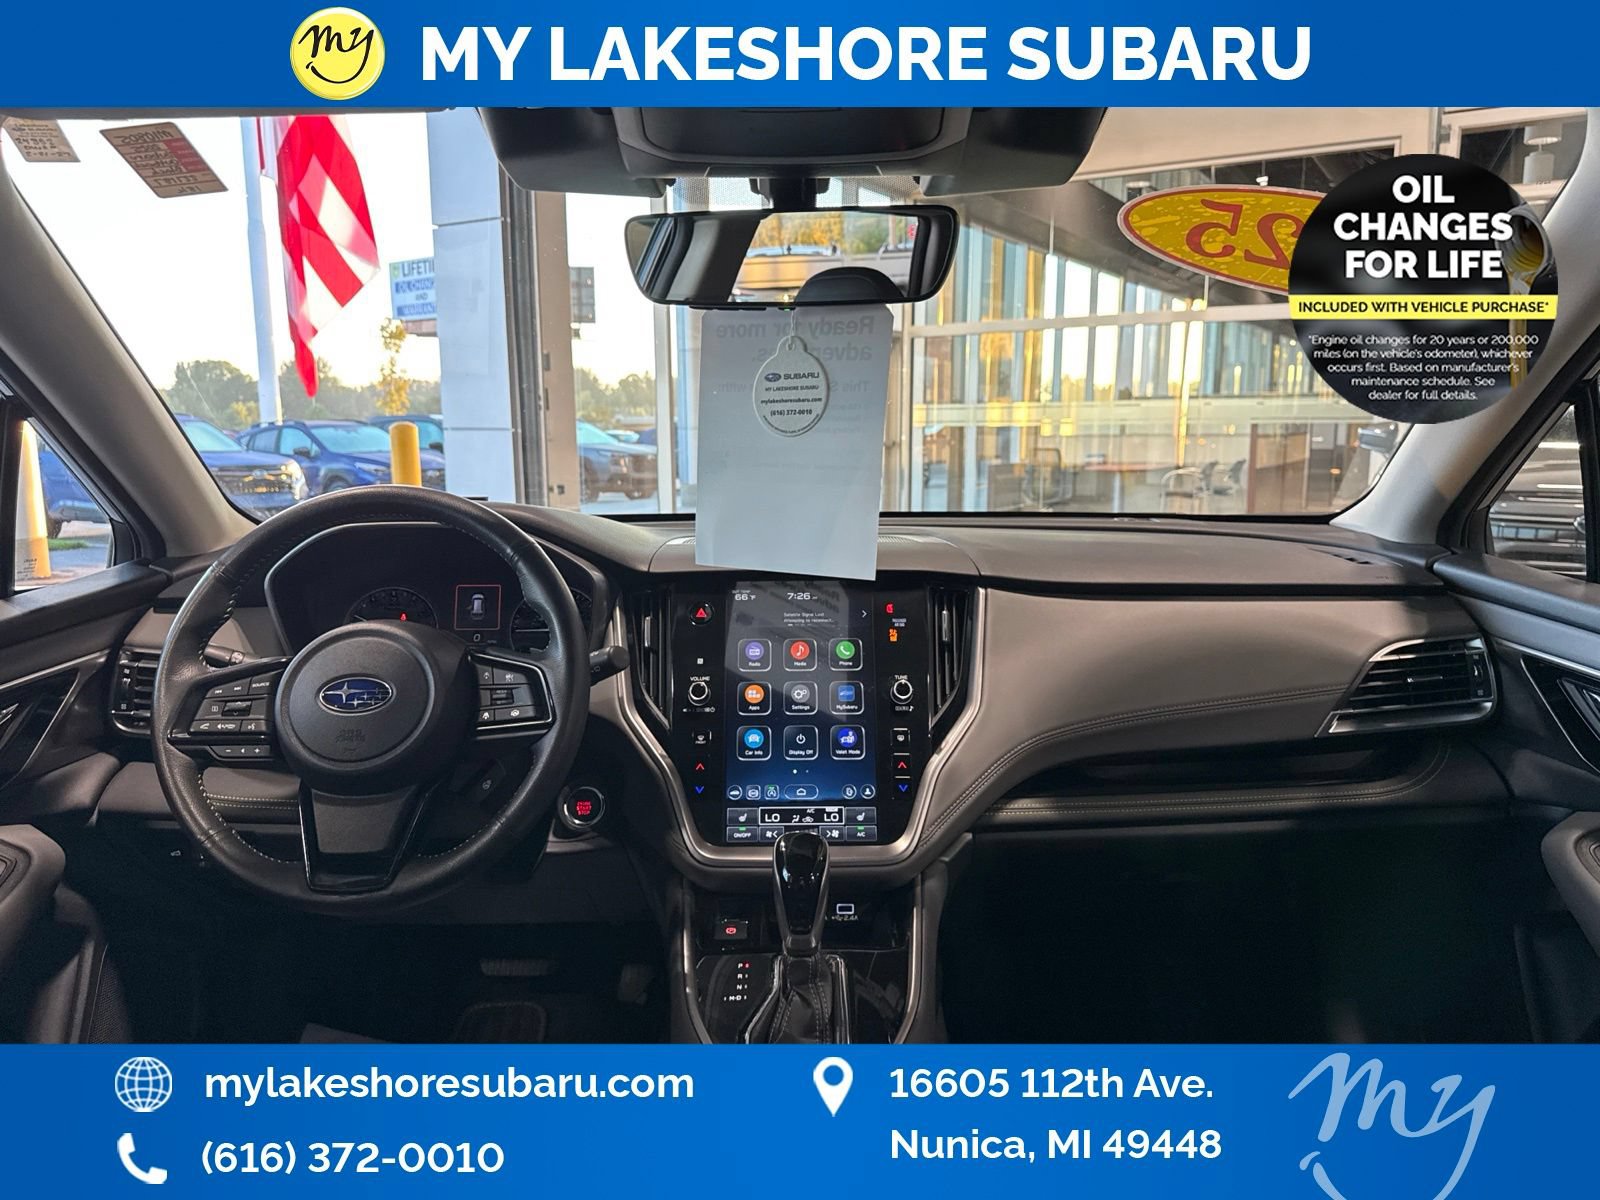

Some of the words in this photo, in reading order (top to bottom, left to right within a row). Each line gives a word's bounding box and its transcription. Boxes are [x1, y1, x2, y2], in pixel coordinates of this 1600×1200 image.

[783, 371, 820, 380] SUBARU
[760, 397, 823, 405] mylakeshoresubaru.com
[770, 409, 785, 417] (616)
[786, 592, 811, 600] 7:26
[765, 813, 780, 822] LO
[824, 812, 839, 822] LO
